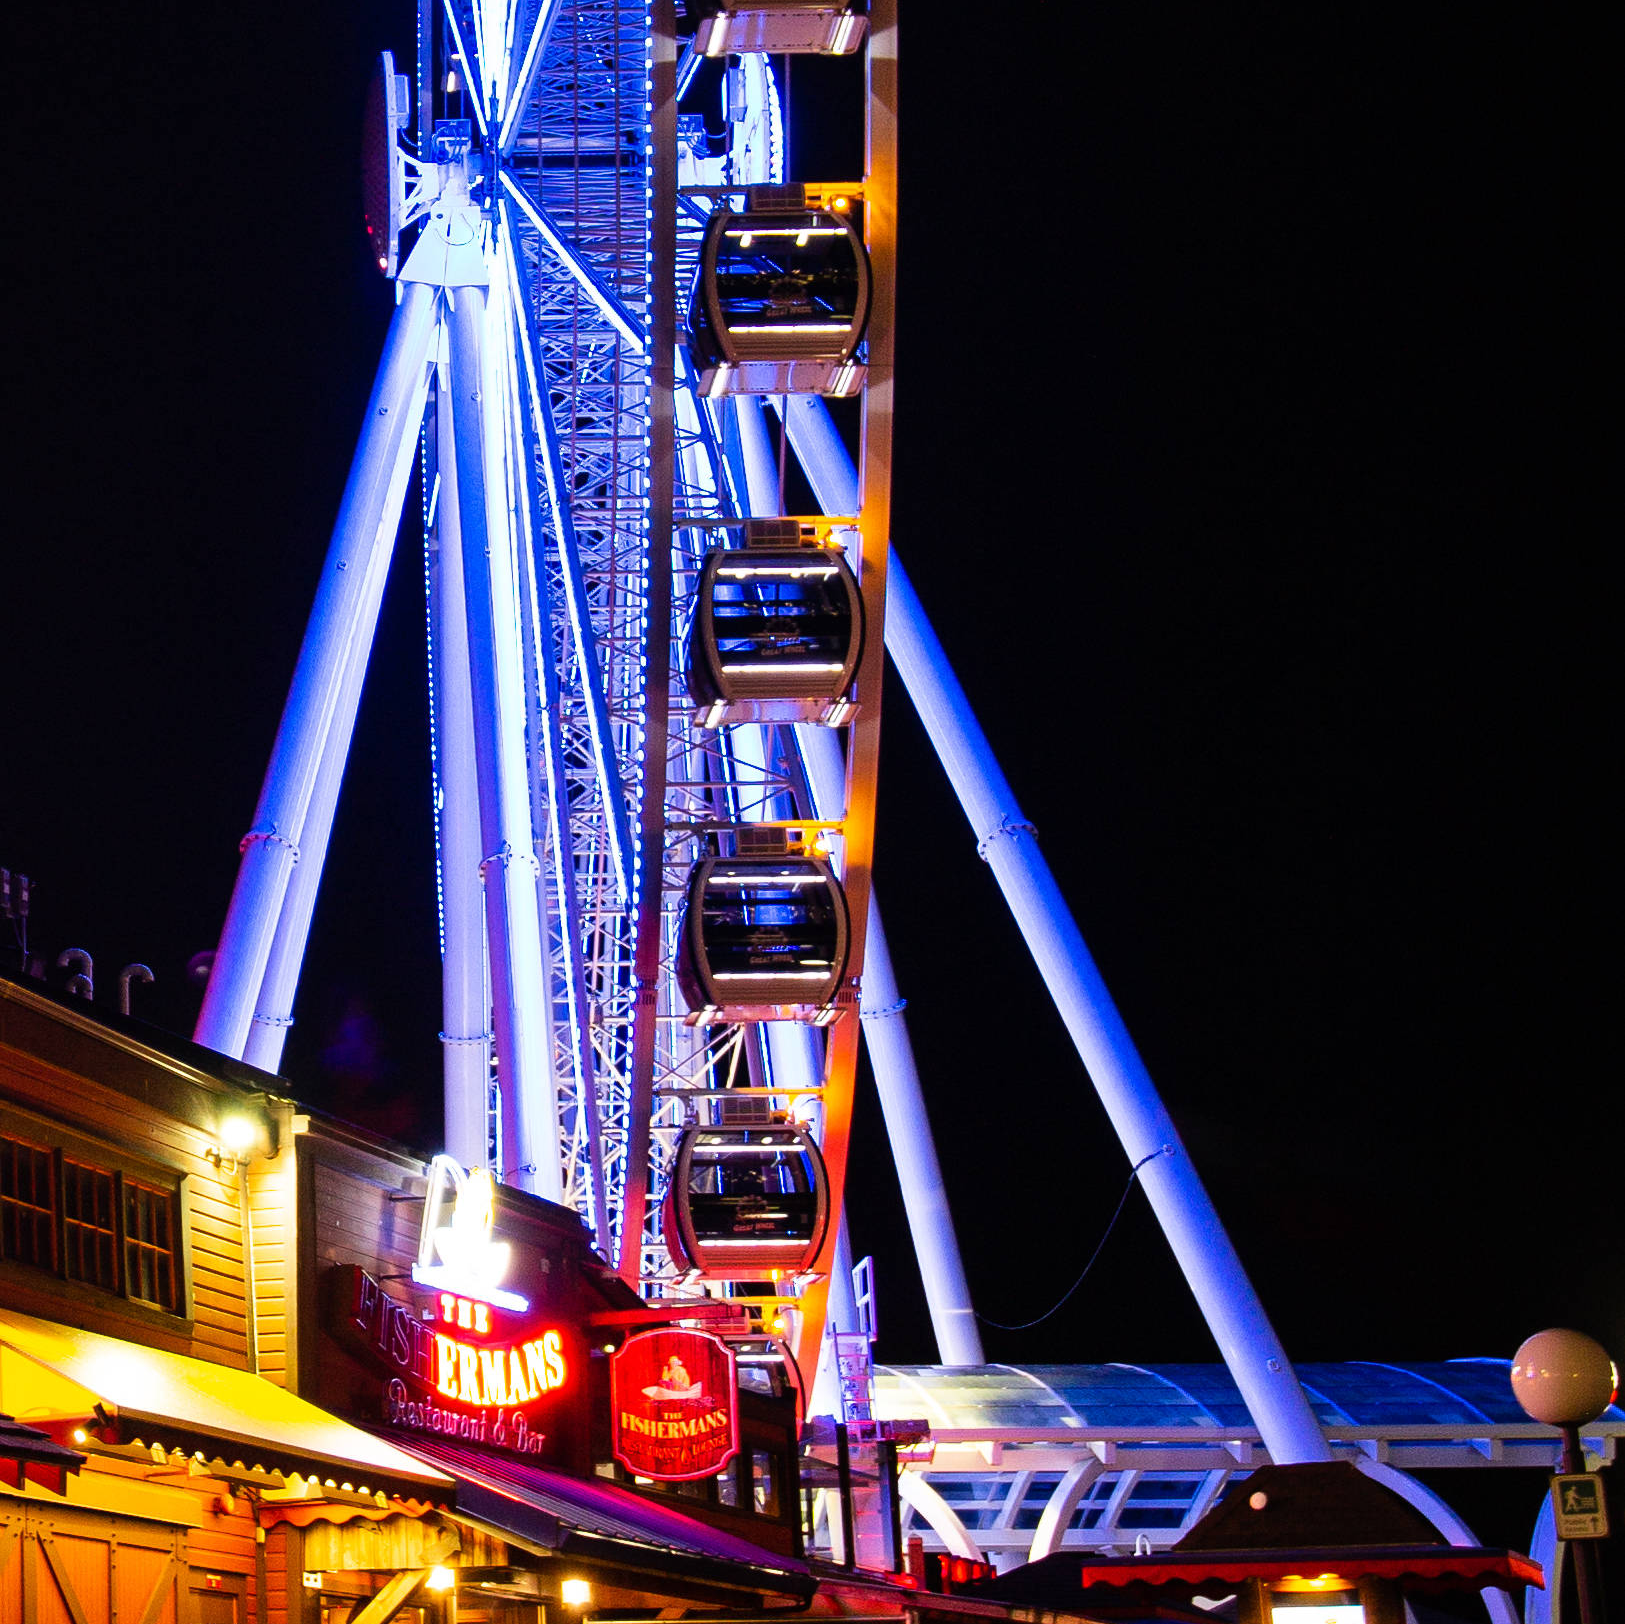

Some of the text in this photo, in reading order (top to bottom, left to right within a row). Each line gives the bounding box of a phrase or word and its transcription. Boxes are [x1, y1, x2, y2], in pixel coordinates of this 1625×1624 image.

[440, 1293, 492, 1334] THE
[387, 1377, 546, 1454] Restaurant & Bar
[621, 1408, 728, 1439] FISHERMANS
[663, 1412, 682, 1420] THE
